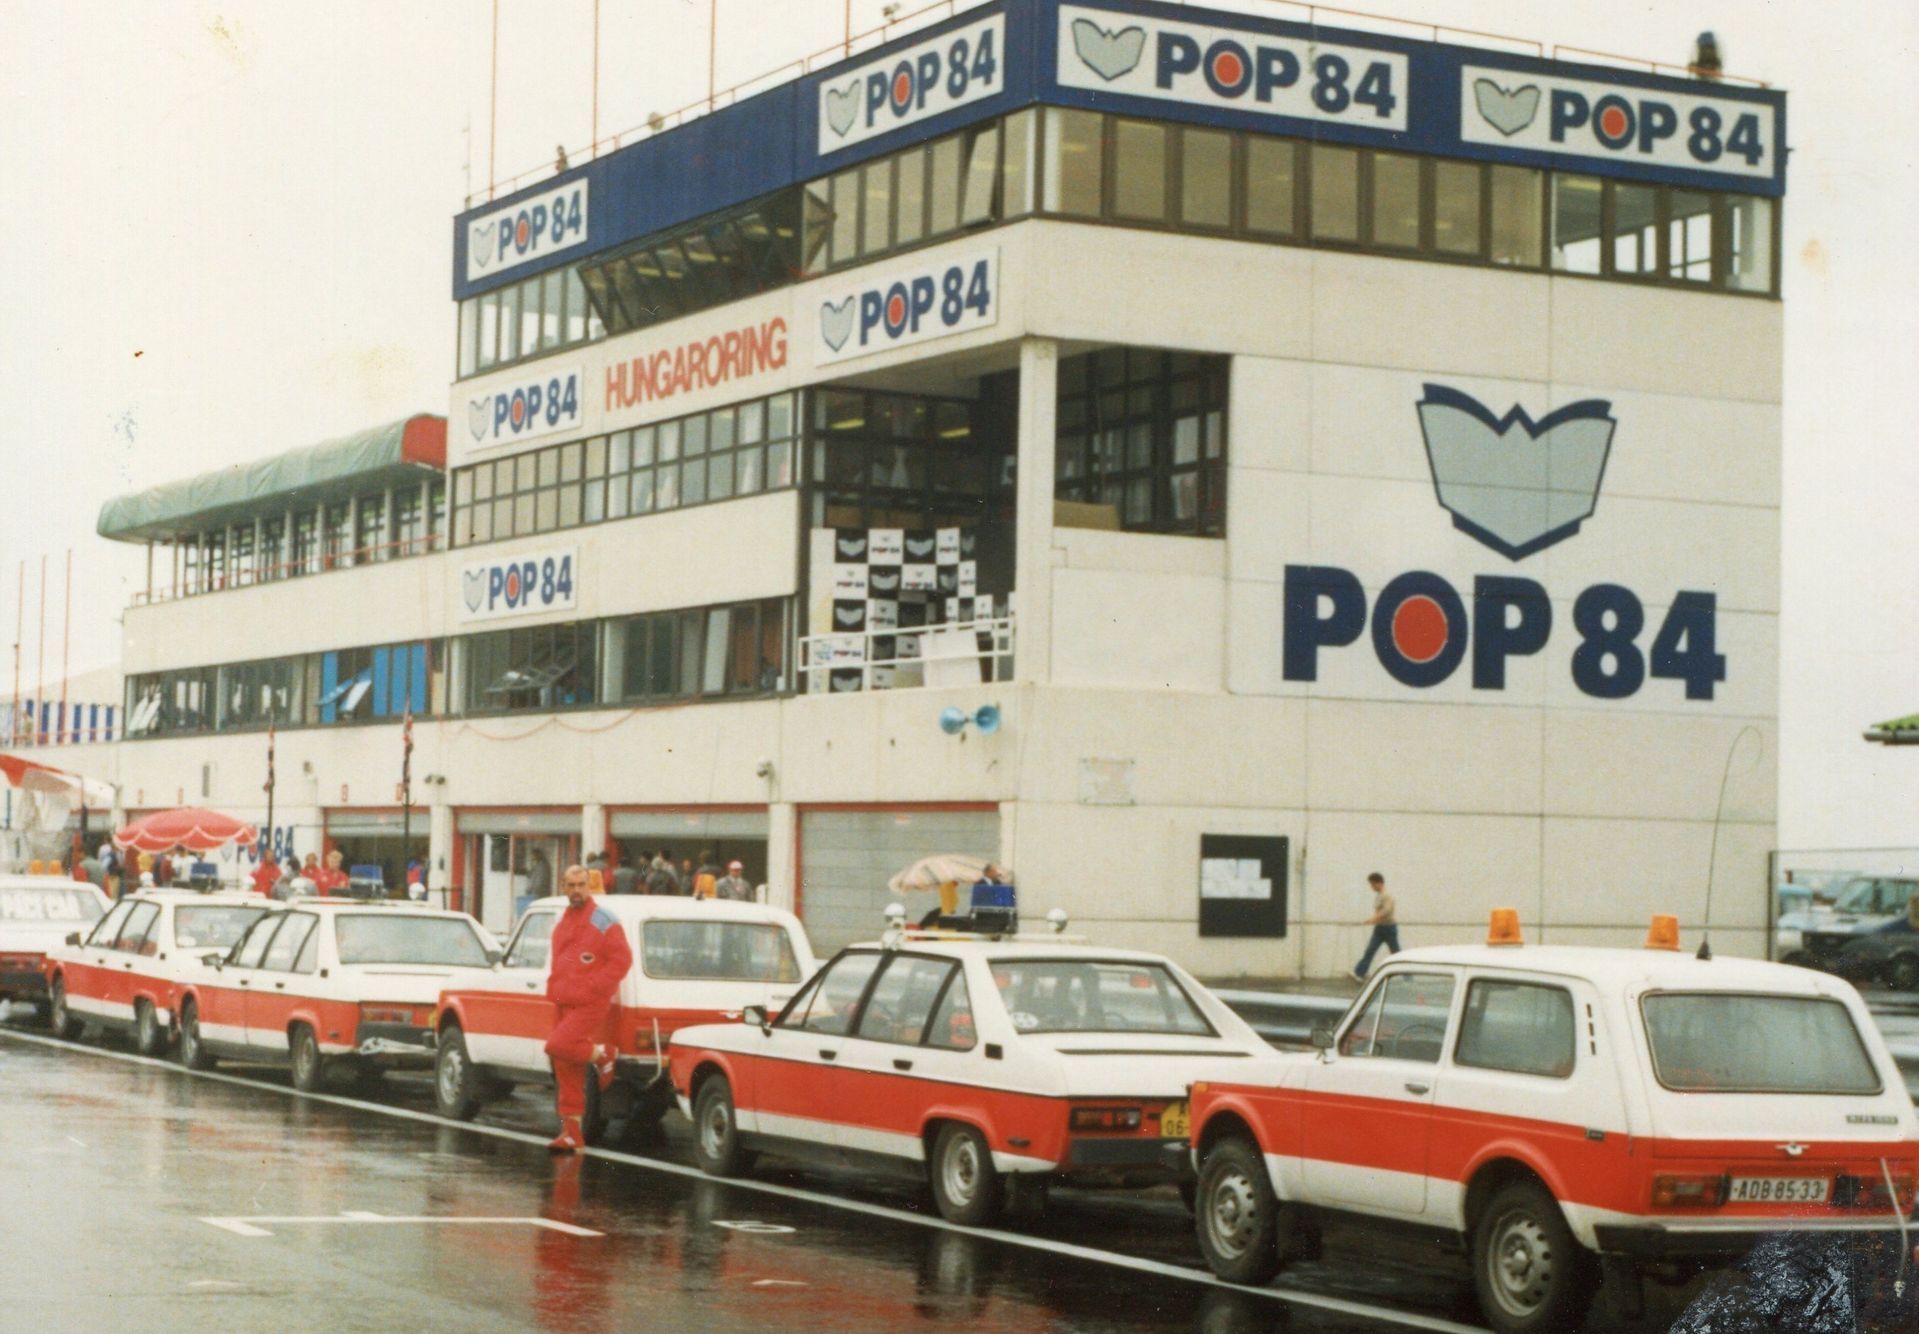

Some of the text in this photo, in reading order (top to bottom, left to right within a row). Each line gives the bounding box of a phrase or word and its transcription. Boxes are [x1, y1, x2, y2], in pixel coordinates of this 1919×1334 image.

[865, 27, 997, 129] POP 84
[1155, 31, 1397, 119] POP 84
[1549, 88, 1764, 166] POP 84
[499, 190, 583, 262] POP 84
[859, 257, 991, 346] POP 84
[494, 374, 578, 438] POP 84
[604, 316, 788, 412] HUNGARORING
[488, 554, 573, 611] POP 84
[1282, 564, 1728, 701] POP 84
